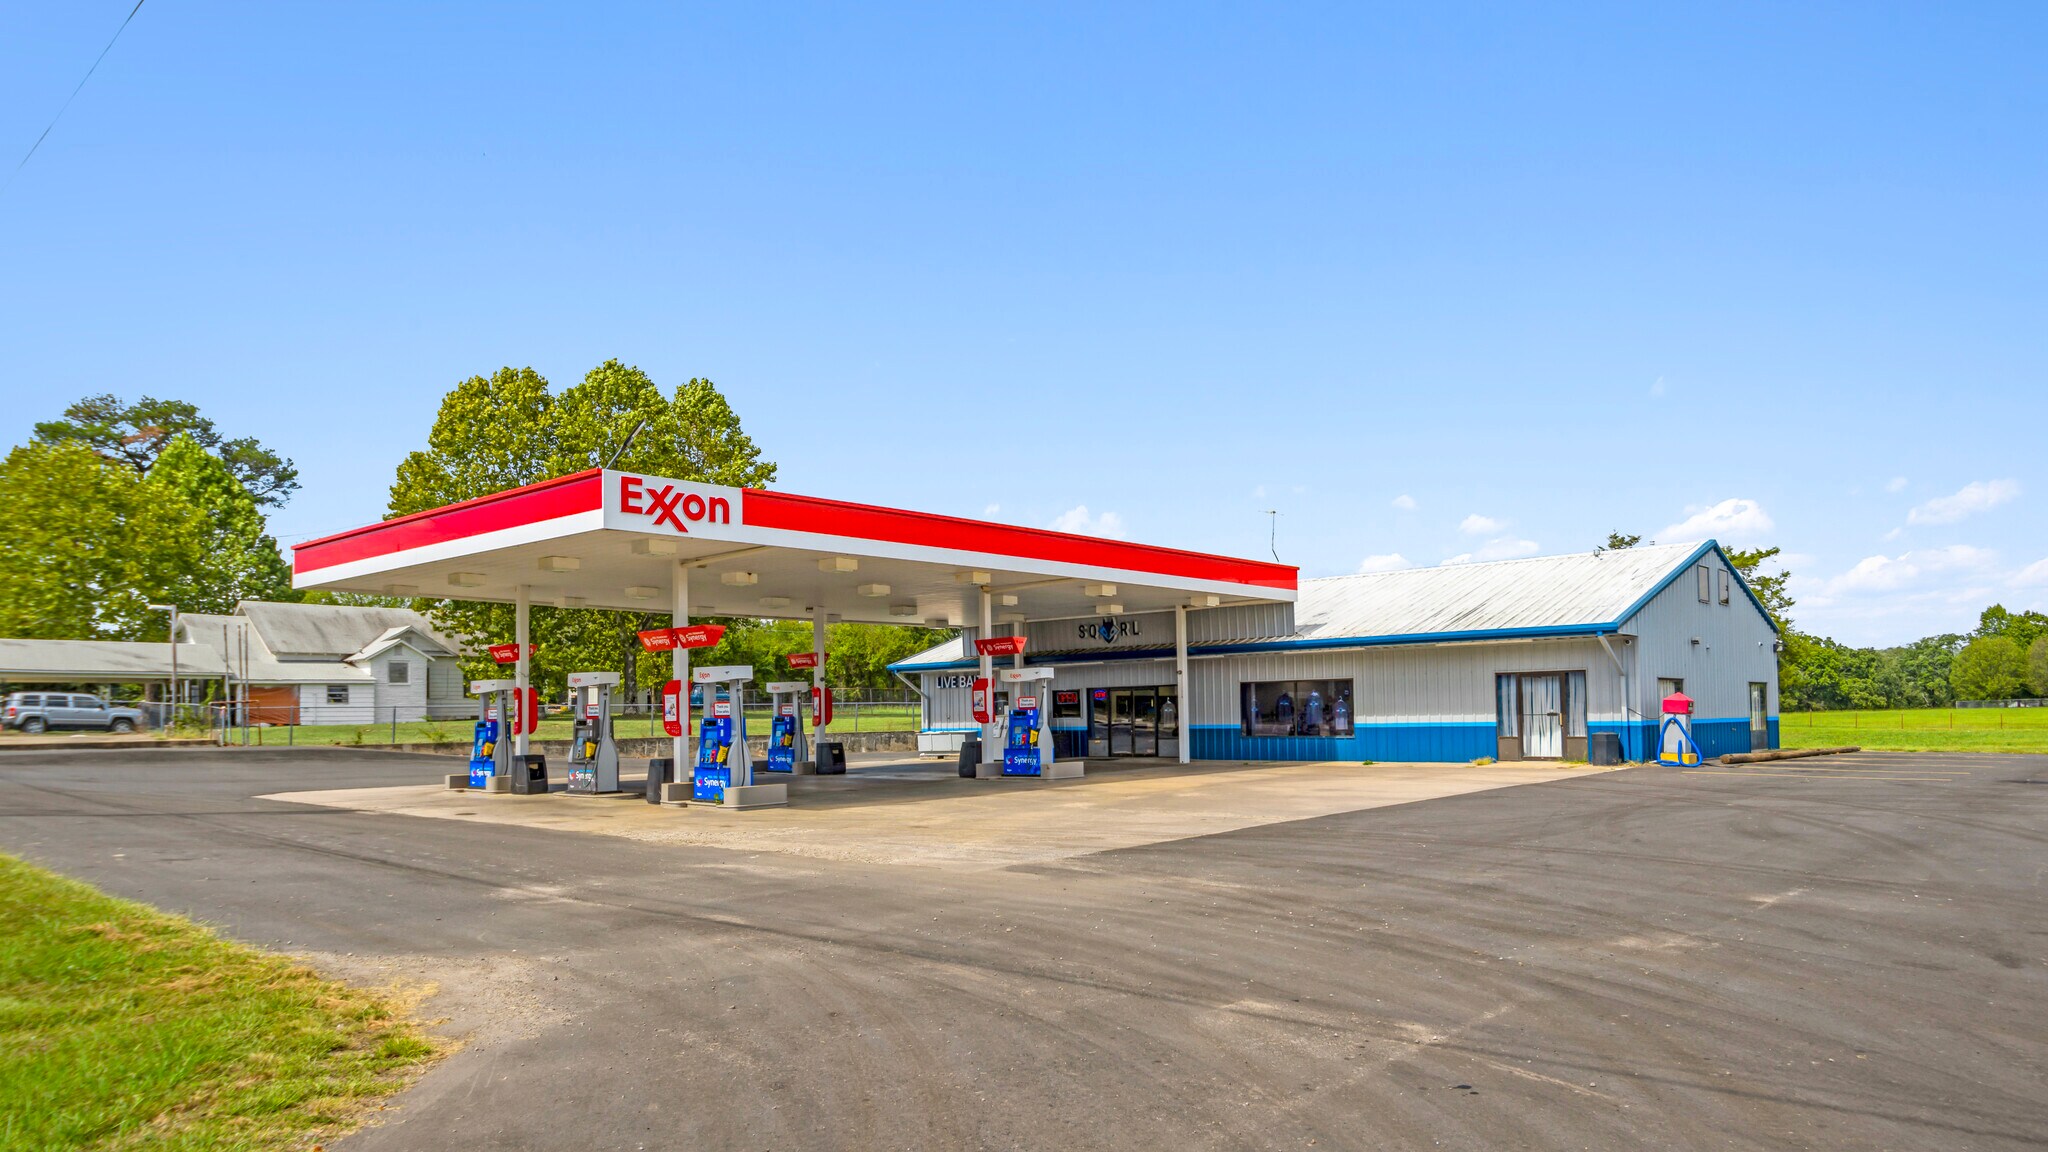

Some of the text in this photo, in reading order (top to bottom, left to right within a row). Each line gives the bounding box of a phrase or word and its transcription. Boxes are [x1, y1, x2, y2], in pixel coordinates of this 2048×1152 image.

[620, 476, 730, 533] Exxon
[650, 638, 671, 646] Synergy
[686, 634, 708, 642] Synergy
[936, 676, 957, 689] LIVE
[1014, 756, 1038, 765] Synergy
[704, 777, 727, 788] Synergy
